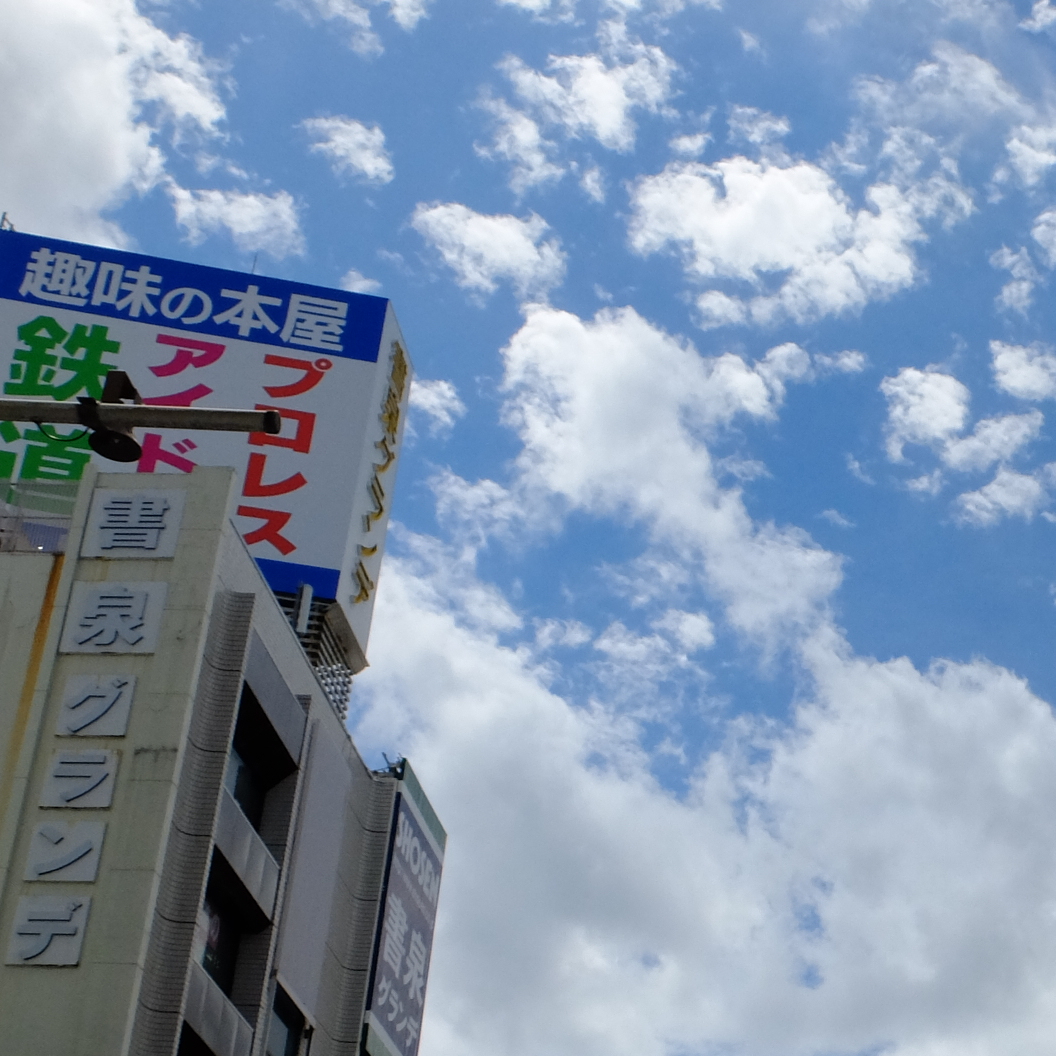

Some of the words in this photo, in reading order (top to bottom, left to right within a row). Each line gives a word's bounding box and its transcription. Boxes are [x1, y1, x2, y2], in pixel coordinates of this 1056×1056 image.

[18, 247, 350, 353] 趣味の本屋
[237, 353, 333, 557] プロレス
[17, 493, 172, 961] 書泉グランデ
[397, 811, 440, 903] SHOSEN
[383, 893, 427, 1007] 書泉
